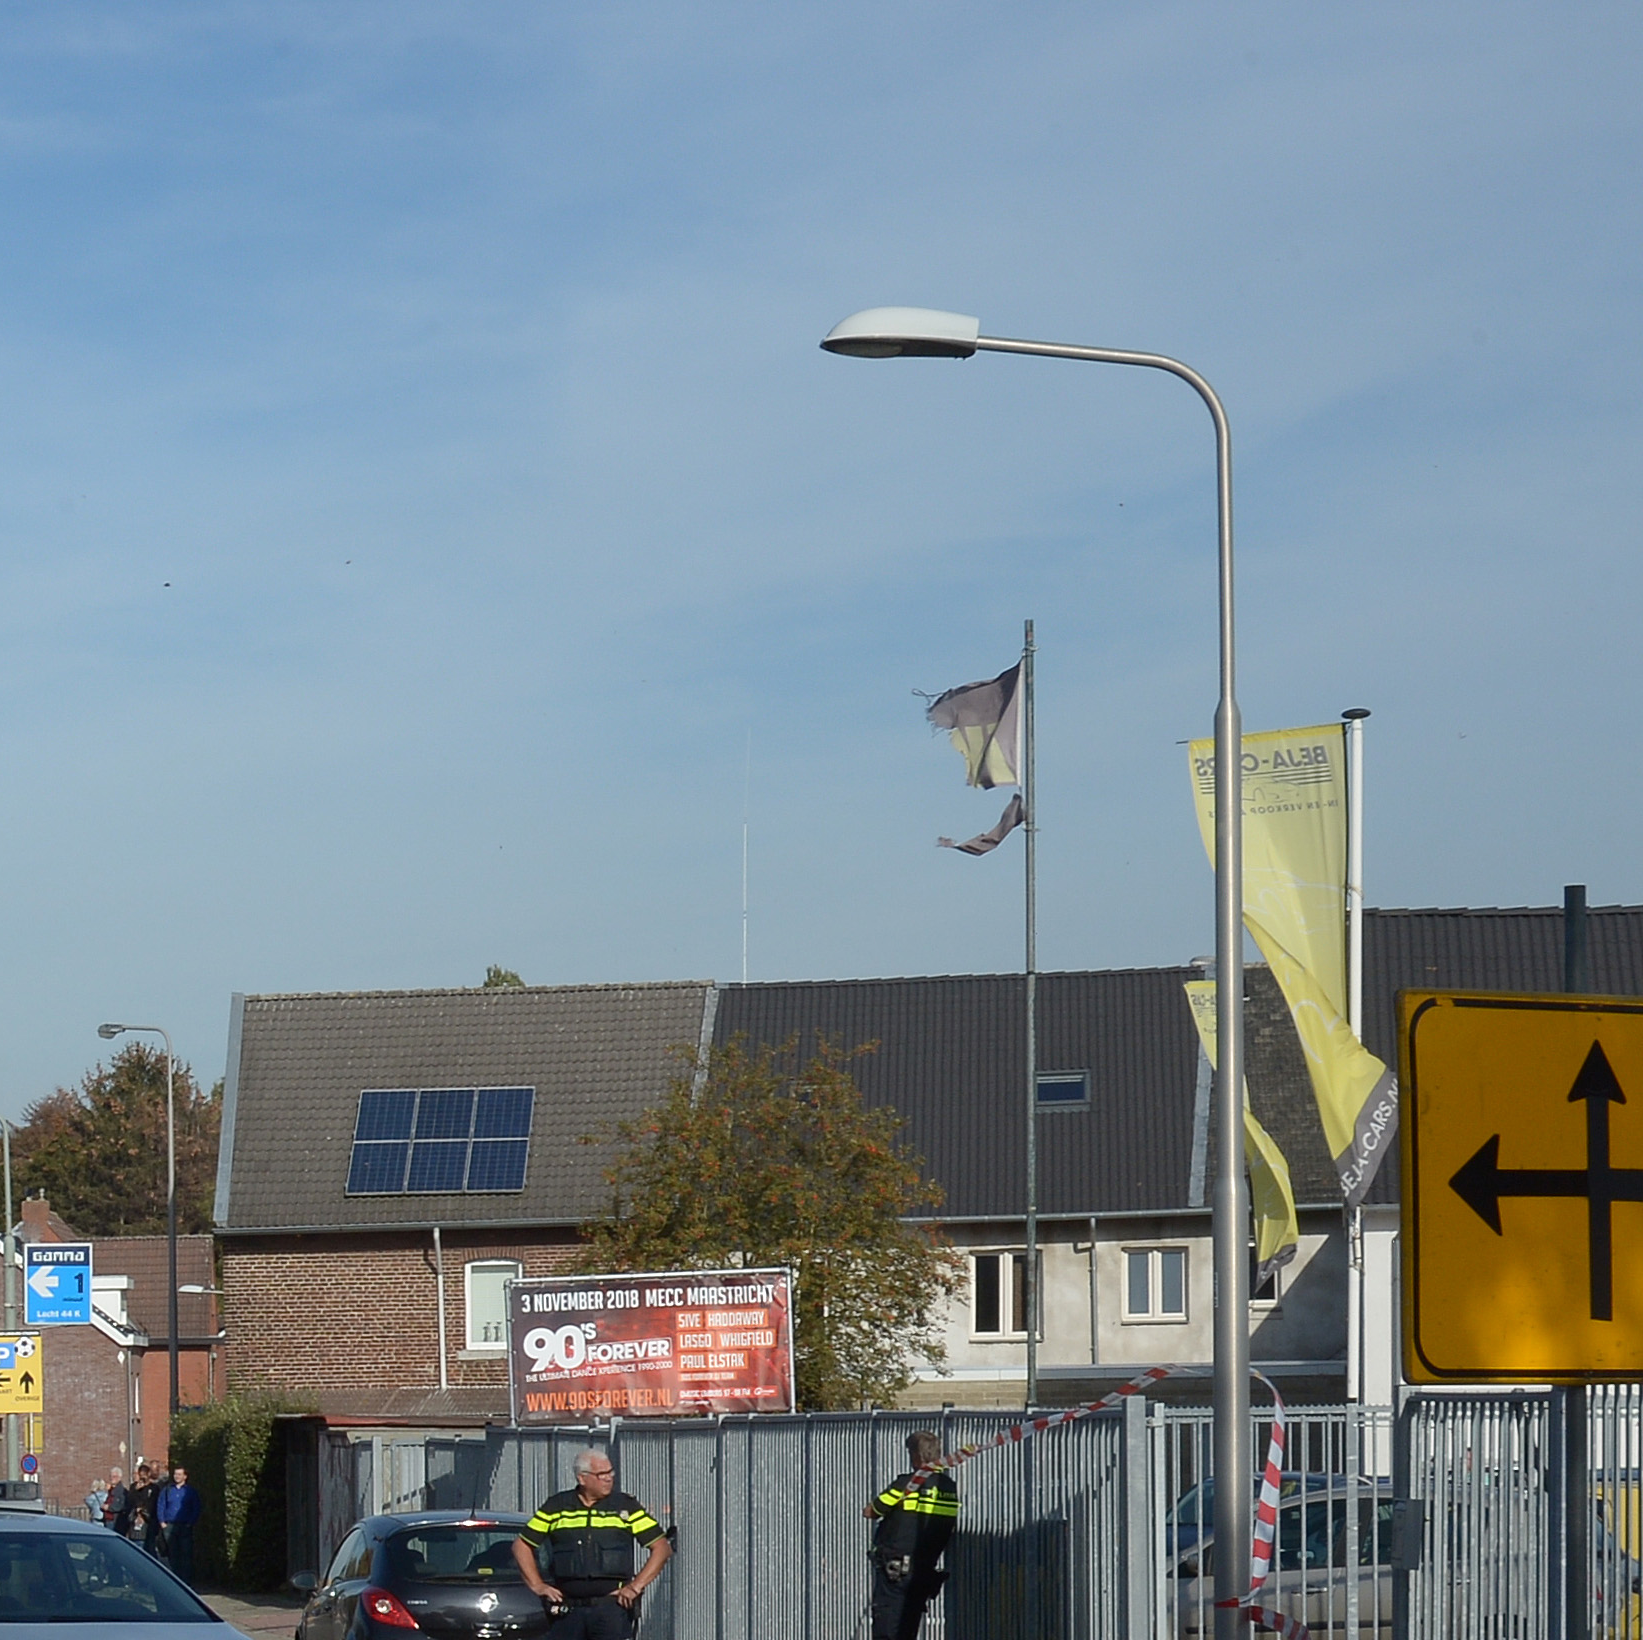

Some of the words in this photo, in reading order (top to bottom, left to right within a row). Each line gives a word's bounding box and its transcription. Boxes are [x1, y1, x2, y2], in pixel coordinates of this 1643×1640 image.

[1340, 1078, 1398, 1197] BEJA-CARS.N
[33, 1252, 84, 1262] GAMMA
[74, 1272, 84, 1293] 1
[521, 1294, 531, 1313] 3
[534, 1290, 604, 1312] NOVEMBER
[607, 1289, 639, 1309] 2018
[645, 1288, 684, 1307] MECC
[687, 1284, 774, 1306] MAASTRICHT
[708, 1311, 765, 1327] HADDAWAY
[523, 1322, 597, 1372] 90'S
[587, 1340, 671, 1363] FOREVER
[679, 1333, 712, 1348] LASGO
[720, 1330, 773, 1347] WHIGFIELD
[680, 1354, 706, 1369] PAUL
[708, 1352, 745, 1367] ELSTAK
[572, 1367, 597, 1378] DANCE
[526, 1388, 674, 1412] WWW.90SFOREVER.NL
